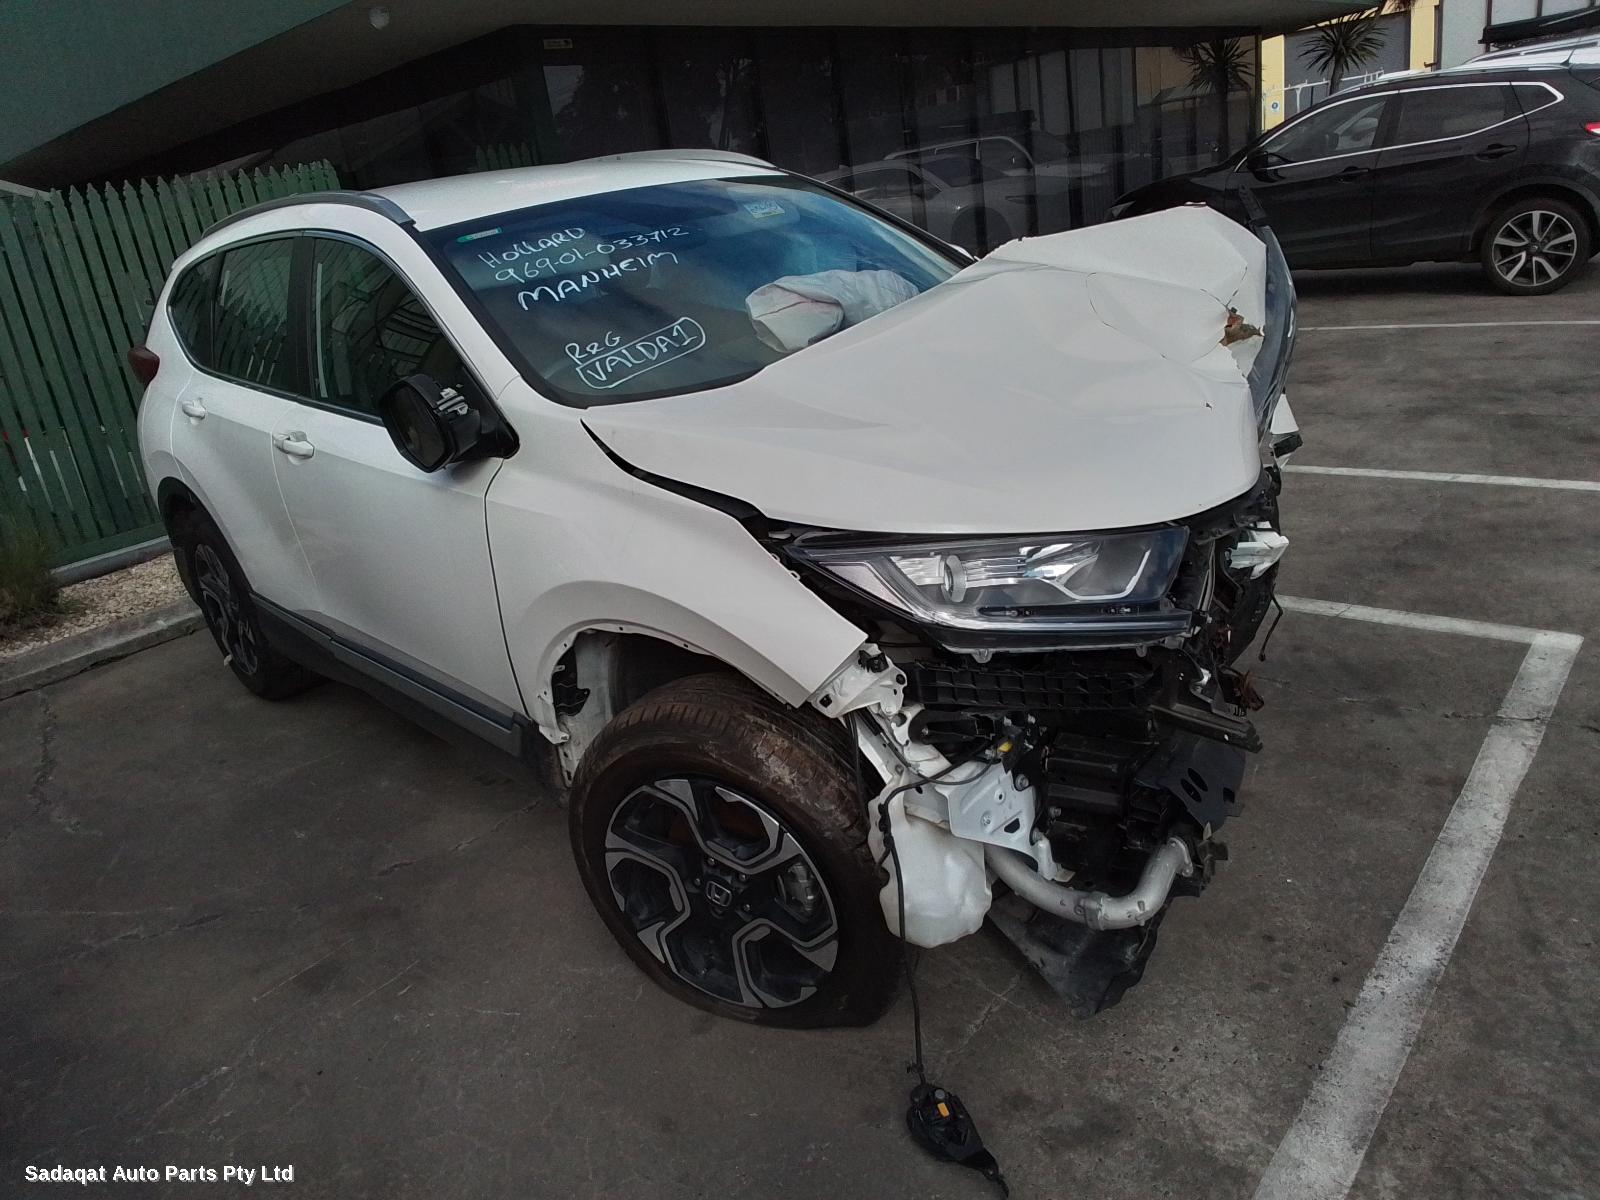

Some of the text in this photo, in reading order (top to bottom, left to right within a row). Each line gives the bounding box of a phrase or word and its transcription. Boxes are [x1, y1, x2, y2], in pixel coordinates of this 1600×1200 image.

[495, 227, 690, 283] 969-01-033712
[517, 252, 678, 311] MANHEIM
[586, 325, 698, 381] VALDA1
